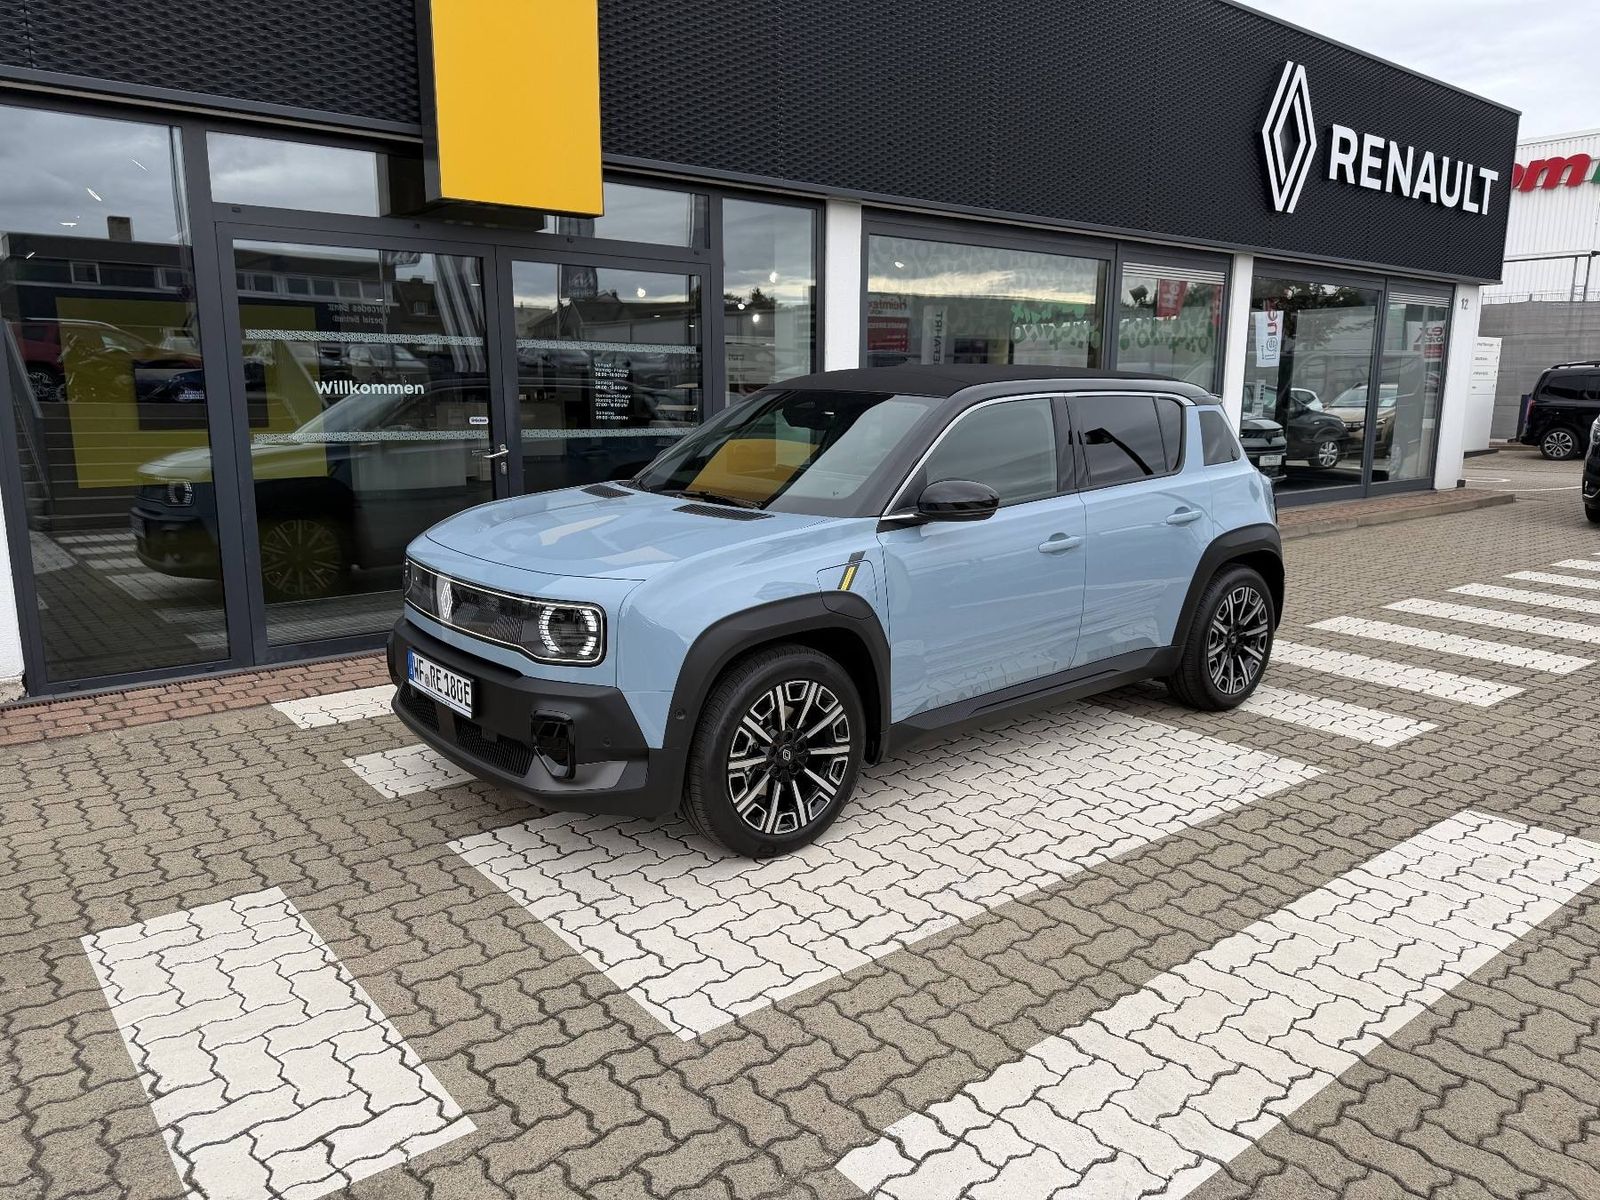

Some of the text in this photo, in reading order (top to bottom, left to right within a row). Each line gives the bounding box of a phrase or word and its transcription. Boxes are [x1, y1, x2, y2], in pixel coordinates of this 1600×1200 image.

[1329, 124, 1499, 215] RENAULT
[1460, 298, 1469, 310] 12
[315, 380, 425, 395] Willkommen
